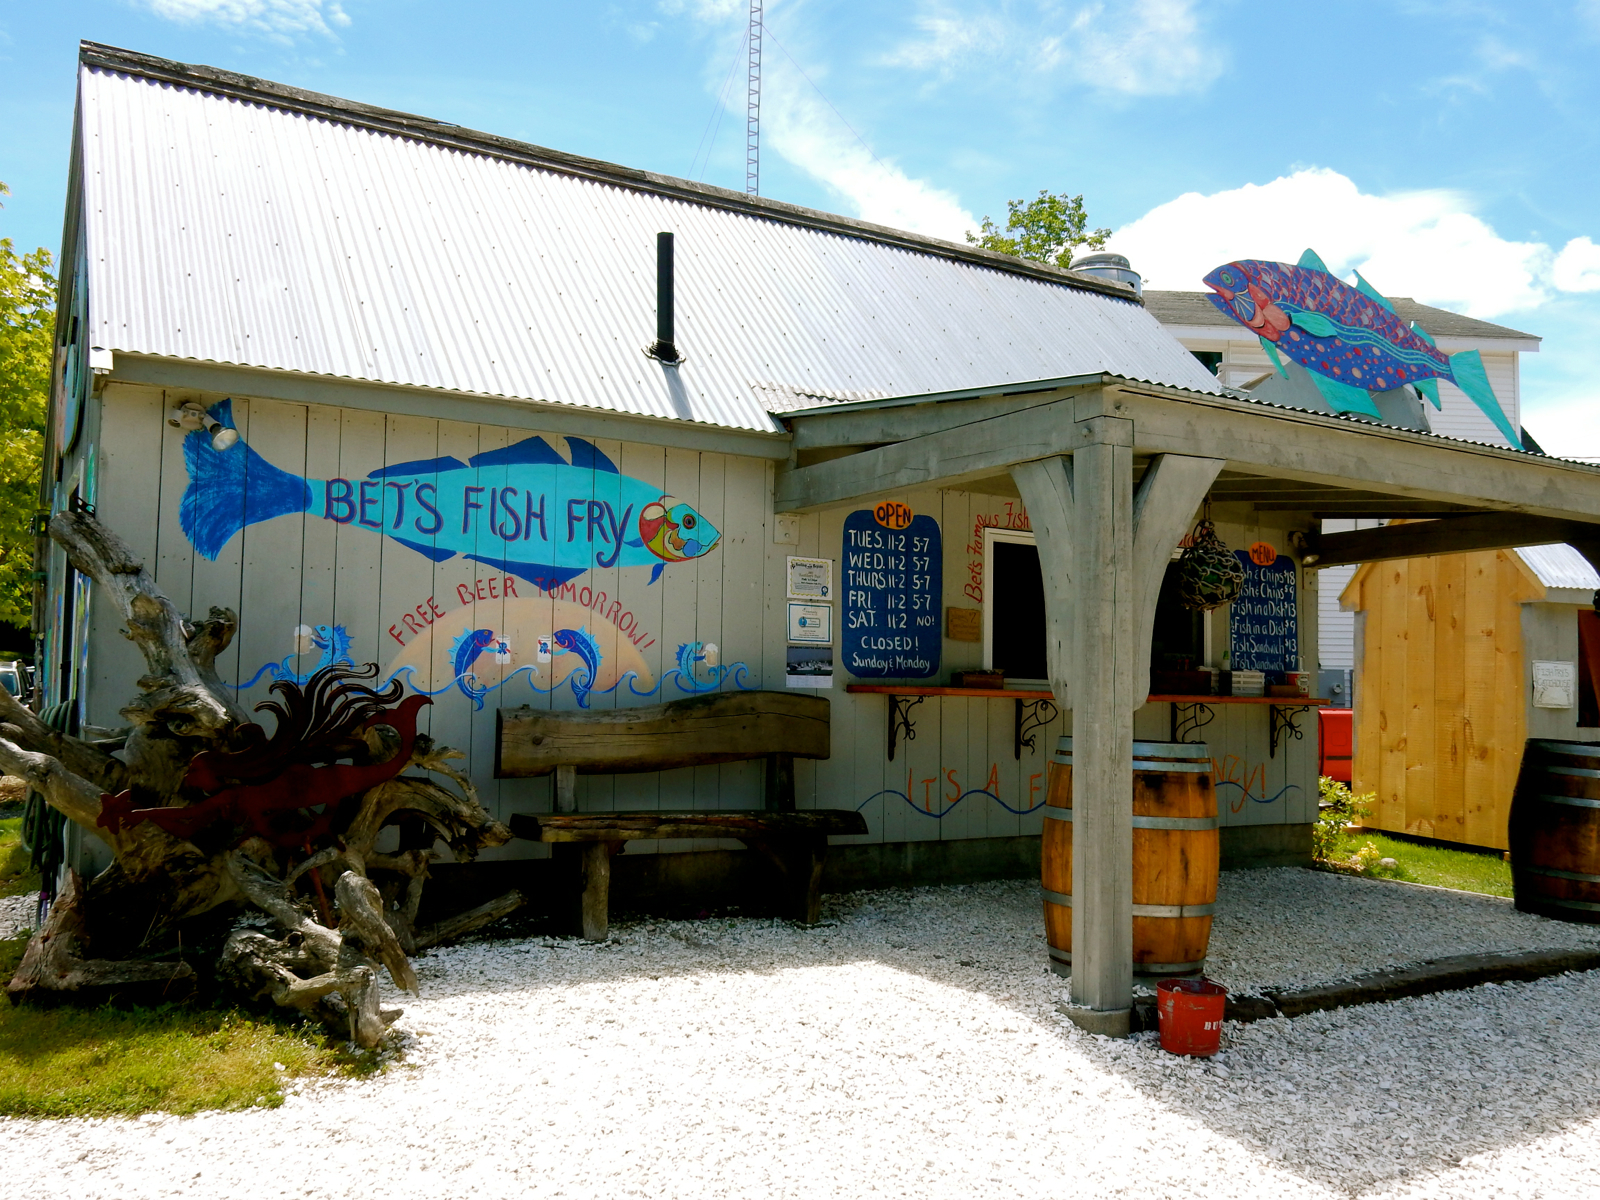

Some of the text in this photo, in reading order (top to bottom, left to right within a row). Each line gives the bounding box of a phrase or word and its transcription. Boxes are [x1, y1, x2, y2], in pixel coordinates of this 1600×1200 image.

[323, 478, 444, 535] BET'S
[461, 485, 549, 543] FISH
[876, 502, 911, 528] OPEN
[1003, 501, 1030, 529] Fish
[848, 529, 930, 553] TUES. 11-2 5-7
[966, 513, 999, 557] Famous
[849, 551, 930, 572] WED. 11-2 5-7
[1251, 545, 1275, 564] MENU
[888, 574, 905, 589] 11-2
[912, 574, 931, 591] 5-7
[964, 560, 983, 604] Bet's
[1260, 567, 1284, 588] Chips
[1283, 569, 1296, 586] $18
[848, 590, 931, 611] FRI. 11-2 5-7
[1240, 581, 1255, 598] ish
[1260, 582, 1284, 605] Chips
[1284, 585, 1295, 600] $9
[388, 576, 656, 655] FREE BEER TOMORROW!
[1231, 598, 1297, 618] Fish in a Dish $13
[848, 609, 878, 629] SAT.
[887, 613, 907, 629] 11-2
[916, 615, 935, 627] NO!
[1234, 616, 1252, 635] Fish
[1252, 620, 1260, 635] in
[1262, 626, 1268, 635] a
[1269, 619, 1288, 636] Dish
[1285, 619, 1296, 634] $9
[860, 635, 919, 651] CLOSED!
[1231, 635, 1297, 655] Fish Sandwich $13
[852, 651, 888, 676] Sunday
[895, 654, 930, 674] Monday
[1250, 653, 1285, 672] Sandwich
[1285, 654, 1296, 668] $9
[907, 766, 962, 814] IT'S
[983, 762, 999, 794] A
